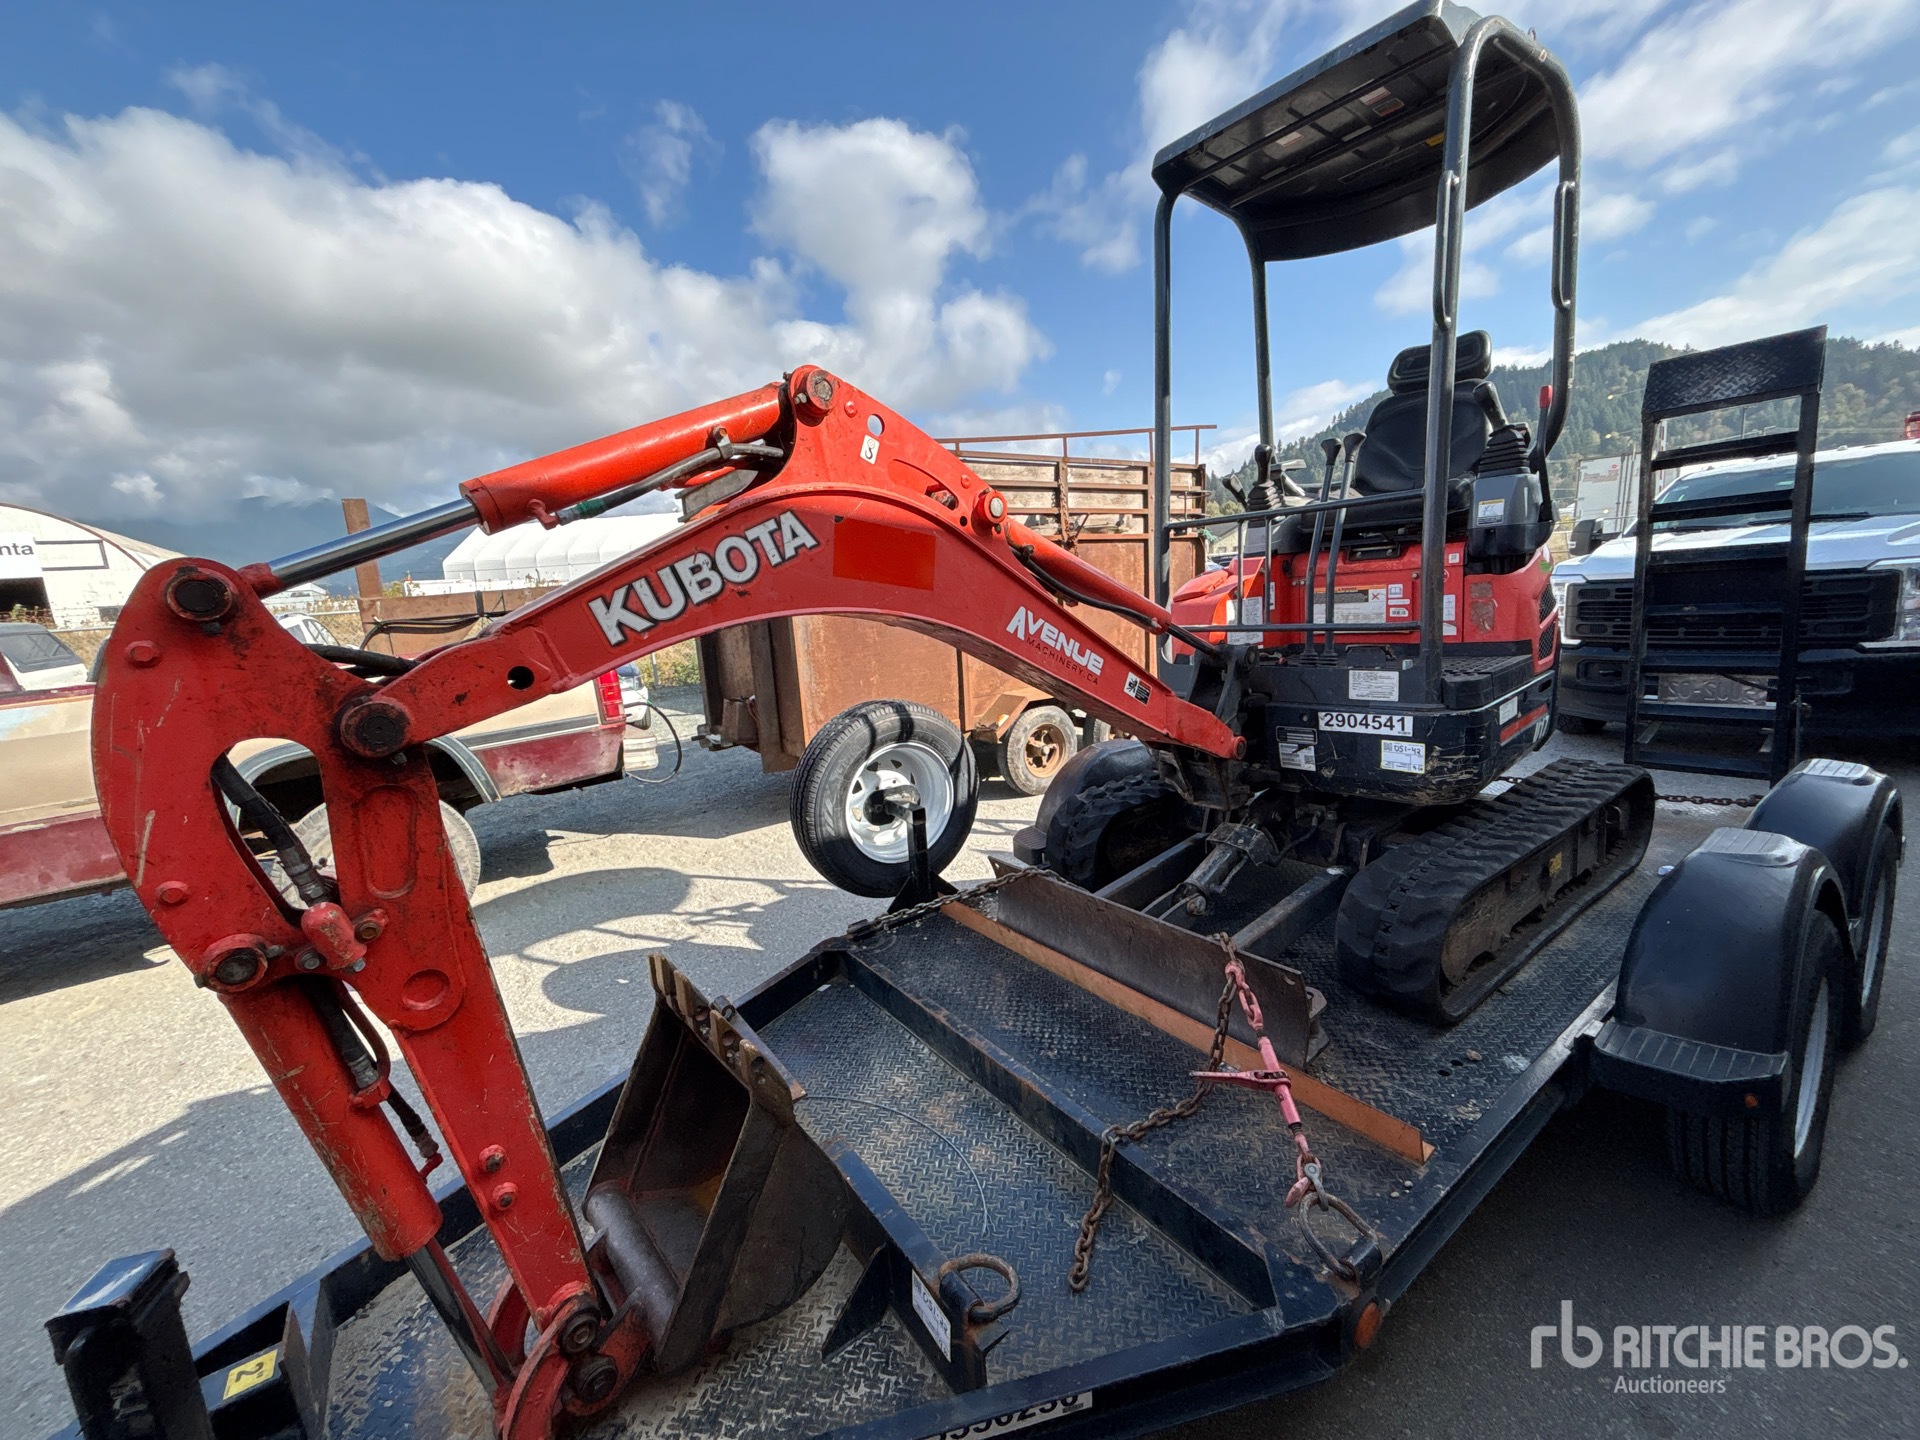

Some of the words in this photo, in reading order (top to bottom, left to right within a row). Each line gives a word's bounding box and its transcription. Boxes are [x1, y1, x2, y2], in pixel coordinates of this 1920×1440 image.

[587, 510, 819, 646] KUBOTA
[1005, 606, 1104, 676] AVENUE
[1026, 637, 1099, 685] MACHINERY.CA
[1323, 713, 1406, 732] 2904541
